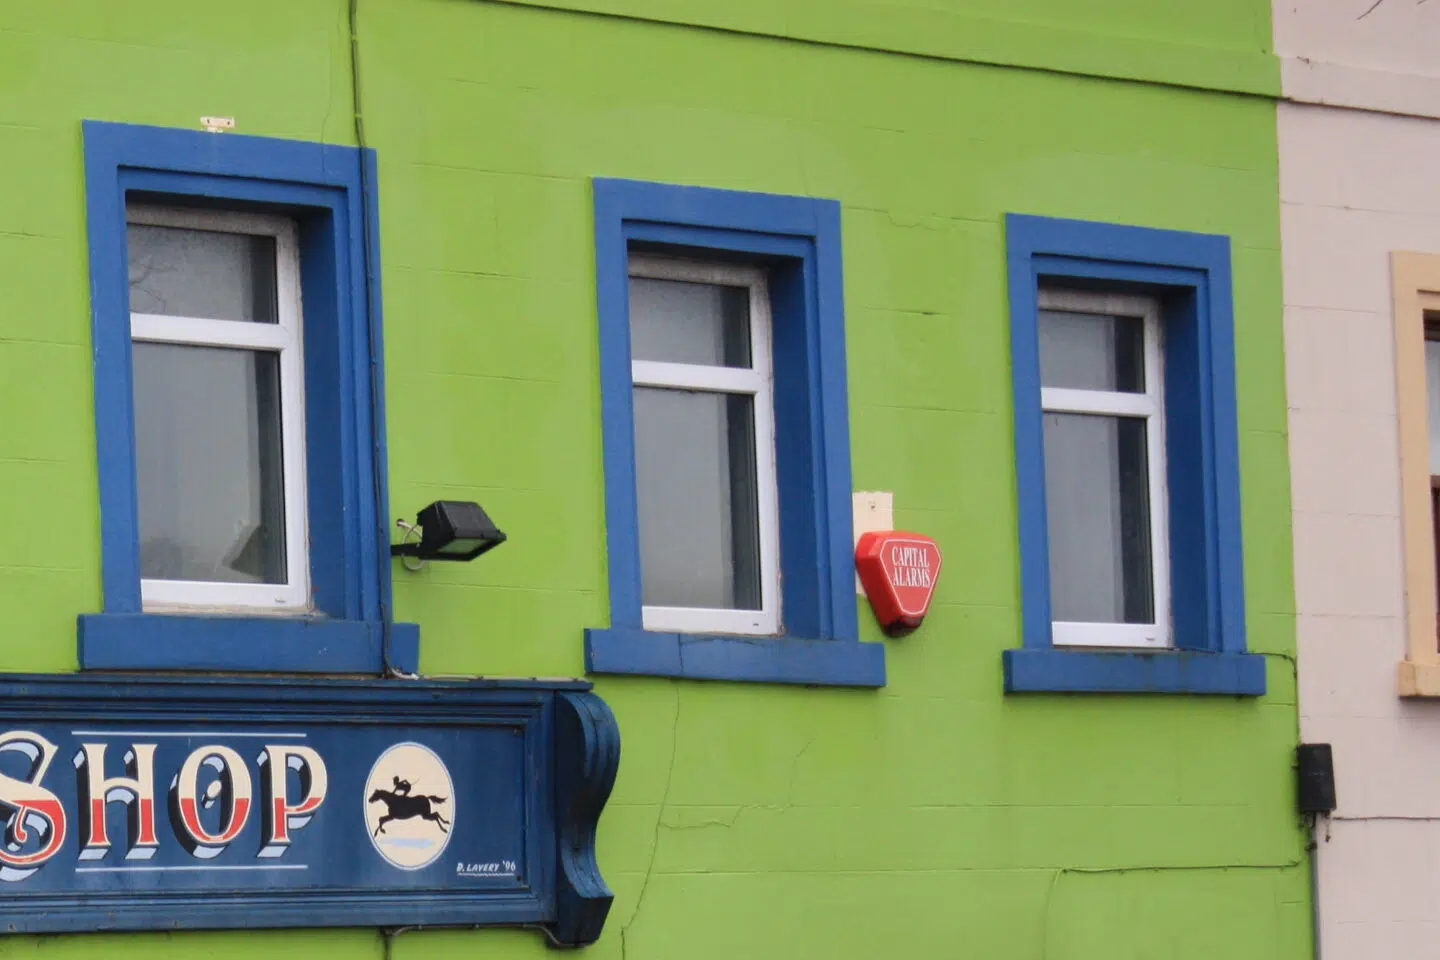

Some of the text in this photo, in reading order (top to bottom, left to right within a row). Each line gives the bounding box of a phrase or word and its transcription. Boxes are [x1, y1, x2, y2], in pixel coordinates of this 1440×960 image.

[892, 546, 930, 568] CAPITAL
[893, 567, 932, 588] ALARMS
[467, 862, 500, 873] LAVERY
[502, 860, 516, 872] '96
